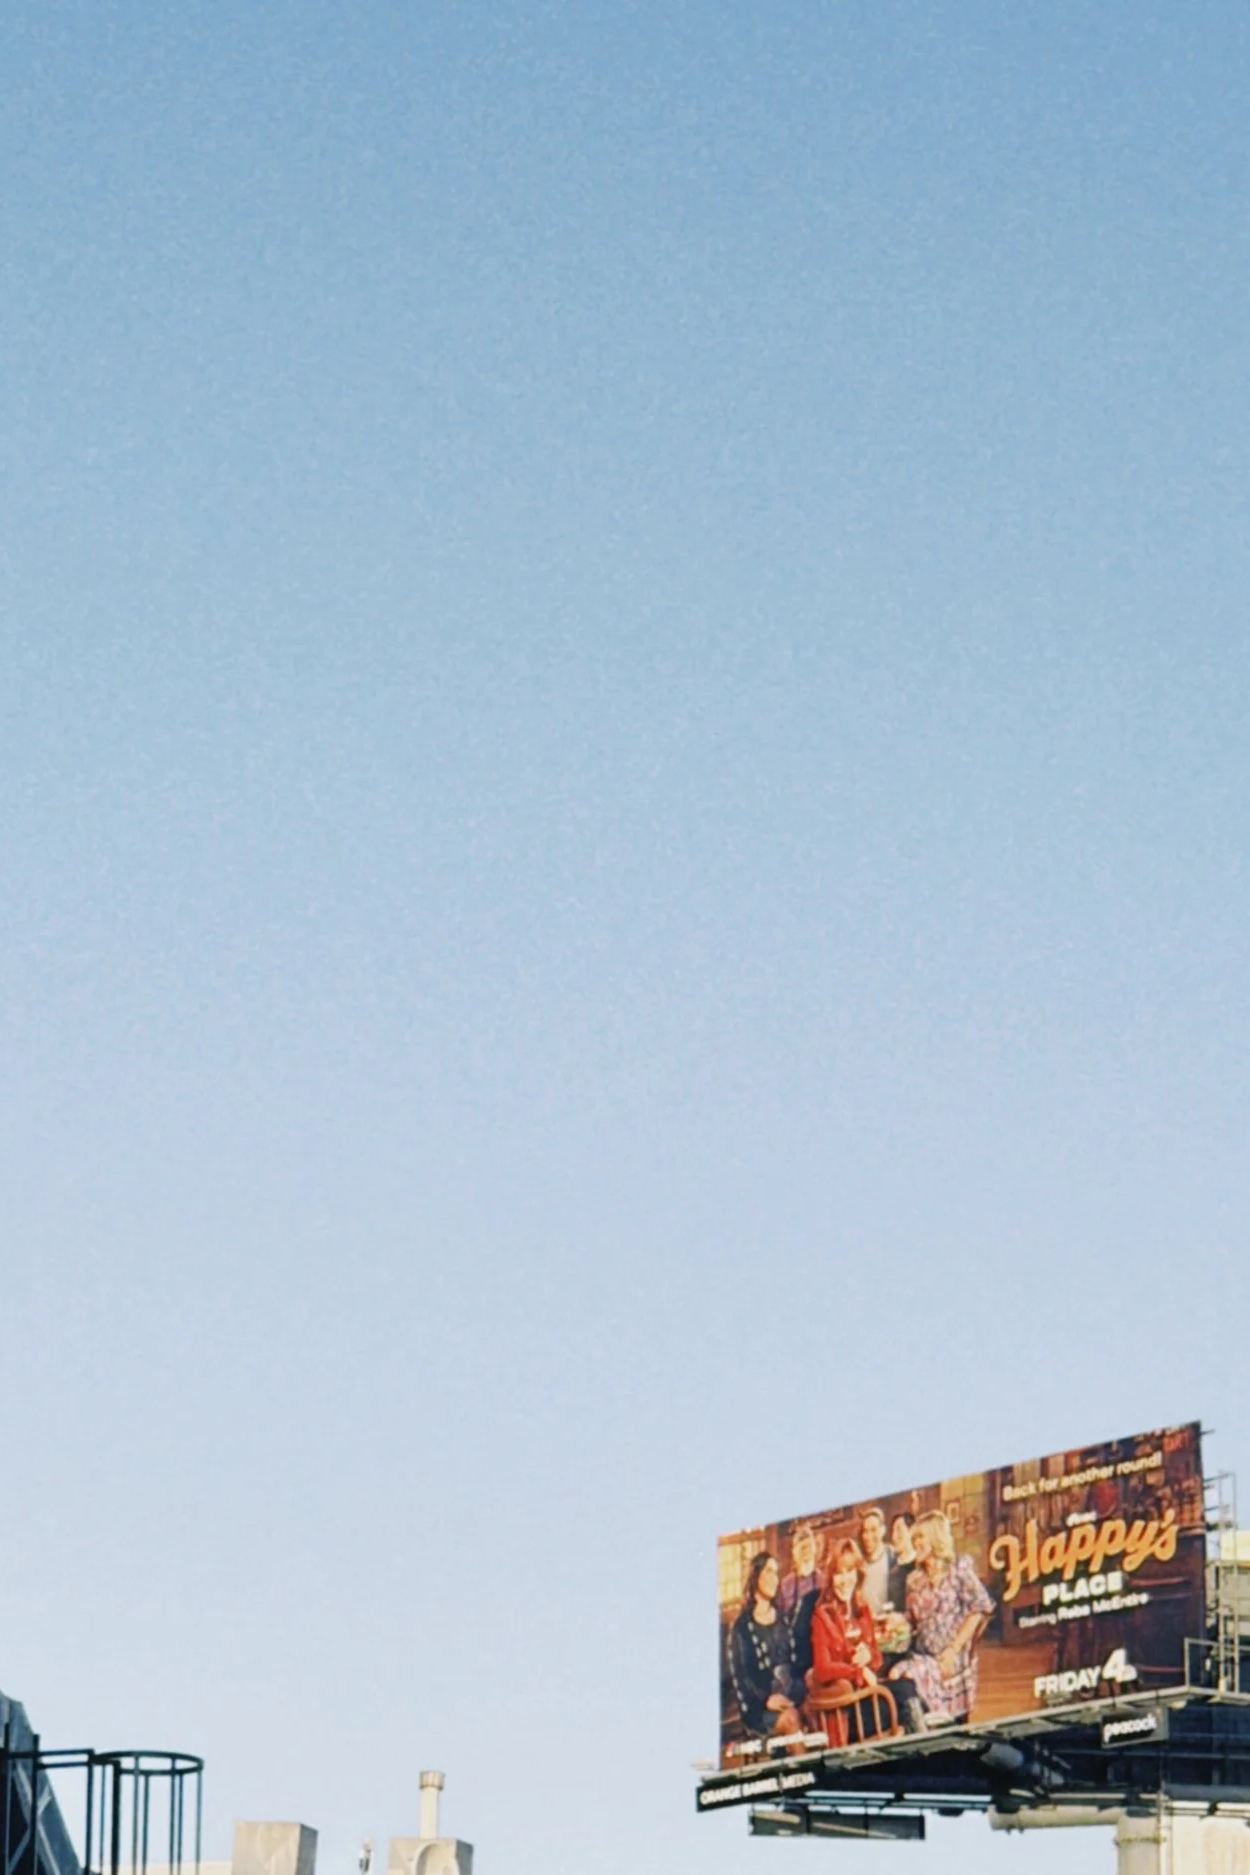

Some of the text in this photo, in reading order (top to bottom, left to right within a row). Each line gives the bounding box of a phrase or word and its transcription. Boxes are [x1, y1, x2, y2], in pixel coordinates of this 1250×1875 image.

[1003, 1450, 1163, 1501] Back for another round!
[990, 1509, 1179, 1602] Happy's
[1042, 1570, 1124, 1607] PLACE
[1034, 1665, 1102, 1699] FRIDAY
[1103, 1712, 1158, 1744] peacock
[782, 1772, 816, 1790] MEDIA
